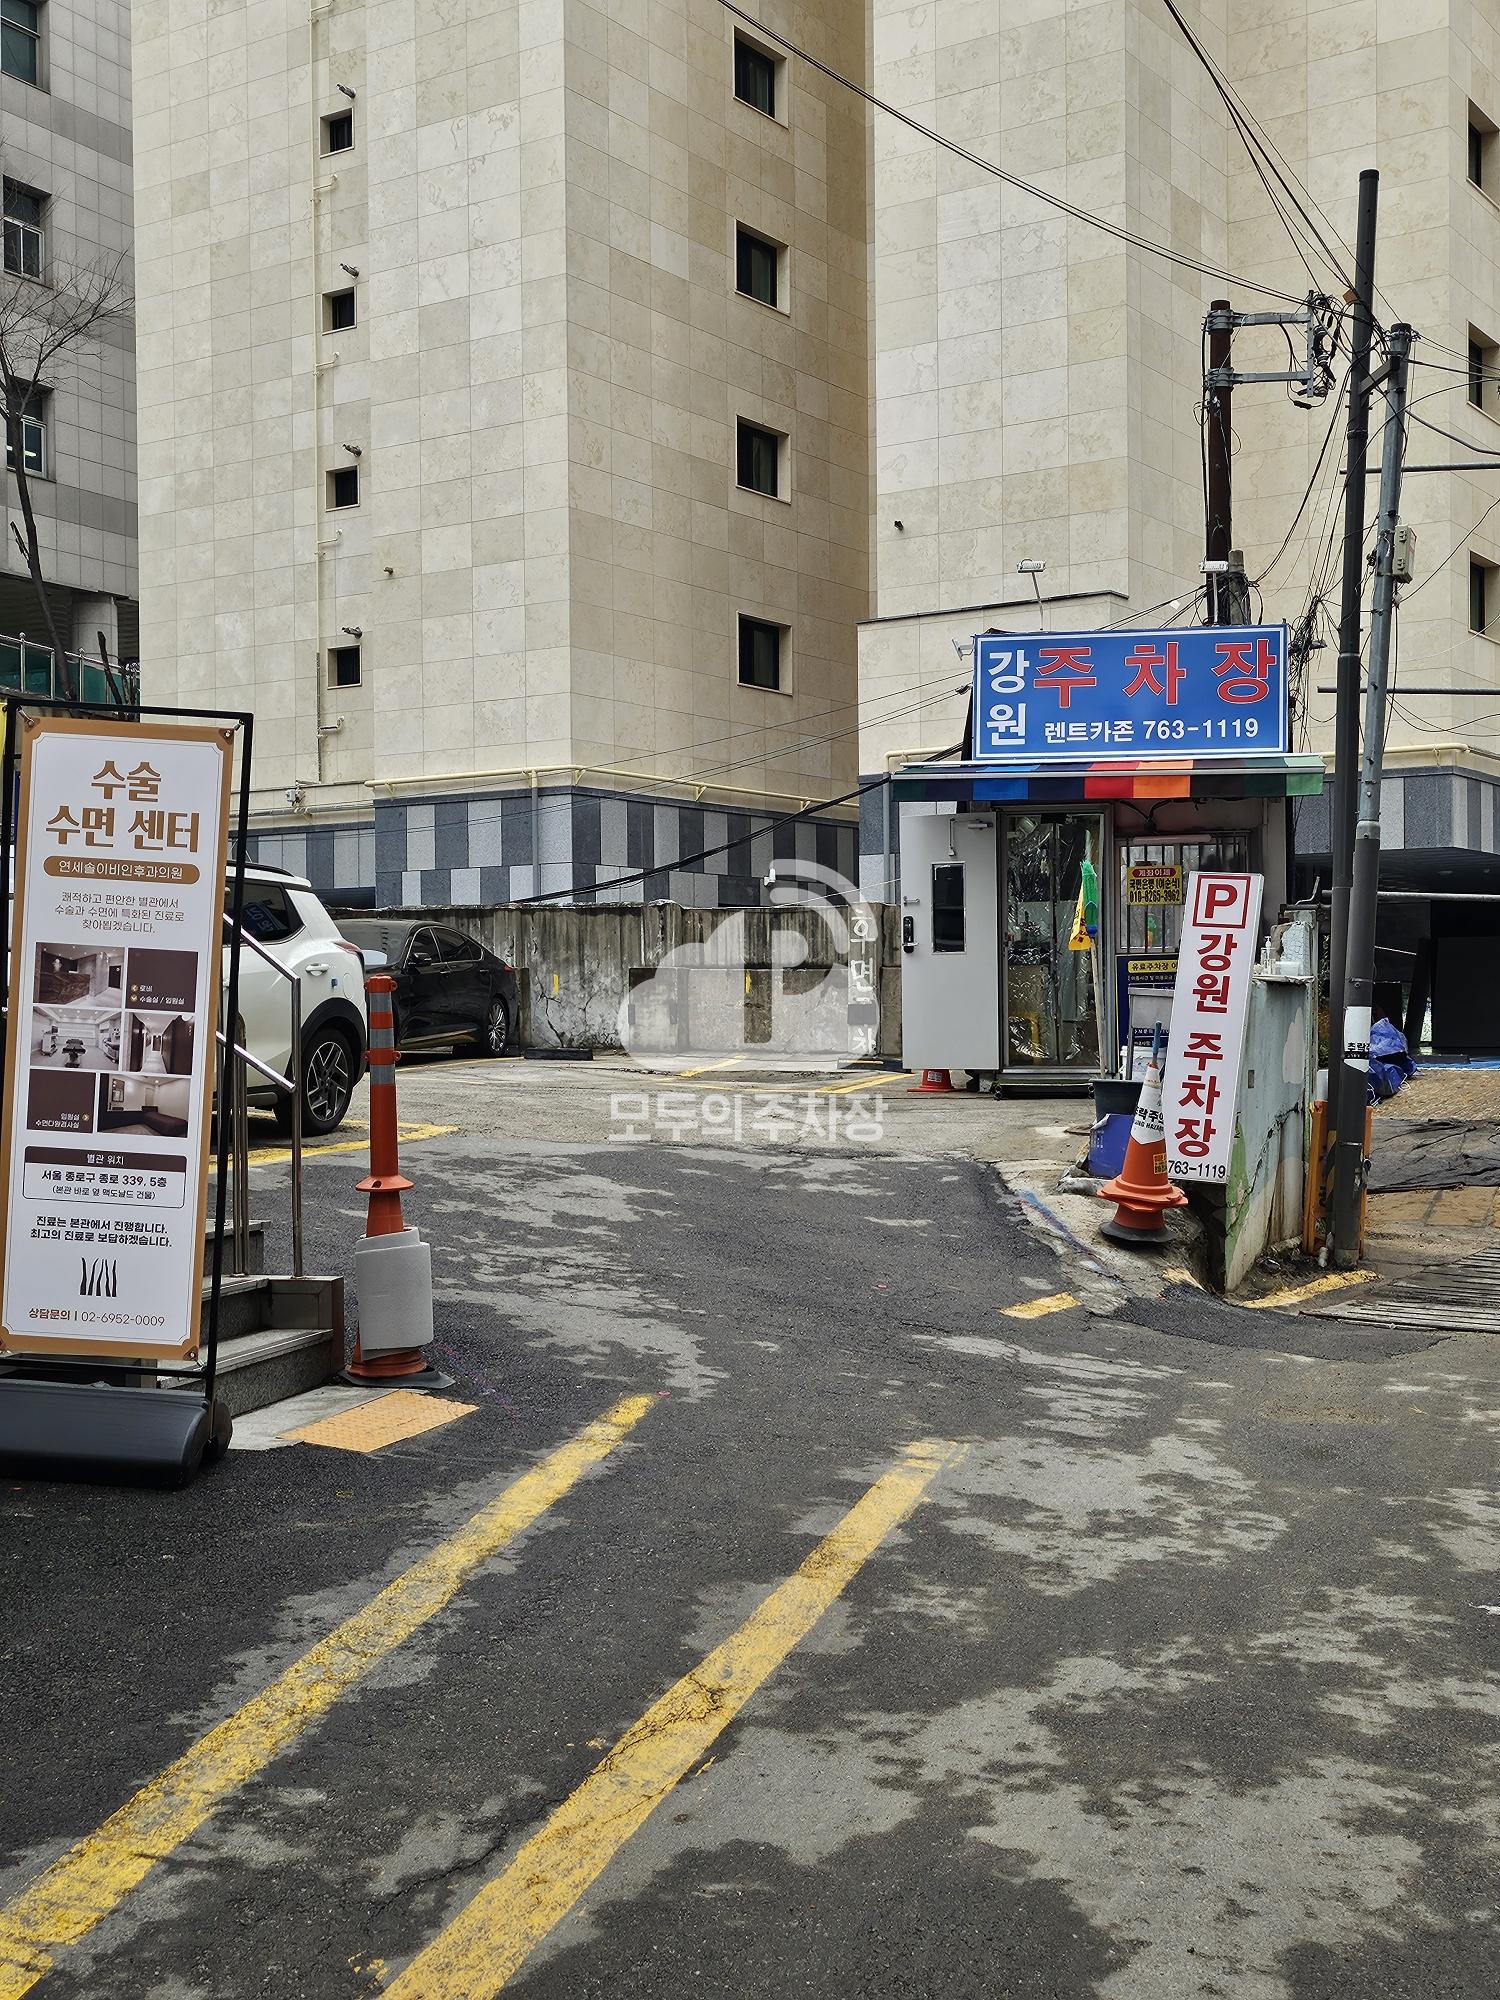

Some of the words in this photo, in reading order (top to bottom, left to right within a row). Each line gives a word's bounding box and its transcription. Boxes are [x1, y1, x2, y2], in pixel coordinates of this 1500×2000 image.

[1034, 639, 1277, 708] 주차장
[986, 650, 1030, 746] 강원
[1044, 721, 1135, 744] 렌트카존
[1143, 718, 1259, 741] 763-1119
[91, 761, 162, 802] 수술
[45, 806, 115, 847] 수면
[128, 810, 200, 852] 센터
[59, 860, 183, 880] 연세솔이비인후과의원
[62, 891, 102, 904] 쾌적하고
[105, 894, 135, 906] 편안한
[138, 896, 179, 908] 별관에서
[1204, 883, 1238, 919] P
[55, 904, 85, 916] 수술과
[88, 907, 118, 918] 수면에
[121, 909, 151, 920] 특화된
[154, 910, 185, 922] 진료로
[82, 919, 156, 934] 찾아뵙겠습니다.
[1192, 934, 1237, 1014] 강원
[1175, 1033, 1223, 1158] 주차장
[87, 1153, 104, 1164] 별관
[107, 1155, 124, 1165] 위치
[1168, 1160, 1226, 1178] 763-1119
[42, 1170, 62, 1181] 서울
[65, 1171, 95, 1183] 종로구
[99, 1173, 119, 1184] 종로
[122, 1175, 146, 1187] 339,
[150, 1176, 167, 1188] 5층
[74, 1187, 89, 1196] 바로
[36, 1216, 67, 1228] 진료는
[70, 1218, 111, 1230] 본관에서
[114, 1220, 168, 1234] 진행합니다.
[30, 1228, 61, 1240] 최고의
[64, 1230, 94, 1242] 진료로
[98, 1233, 172, 1247] 보답하겠습니다.
[28, 1307, 71, 1321] 상담문의
[81, 1311, 165, 1327] 02-6952-0009
